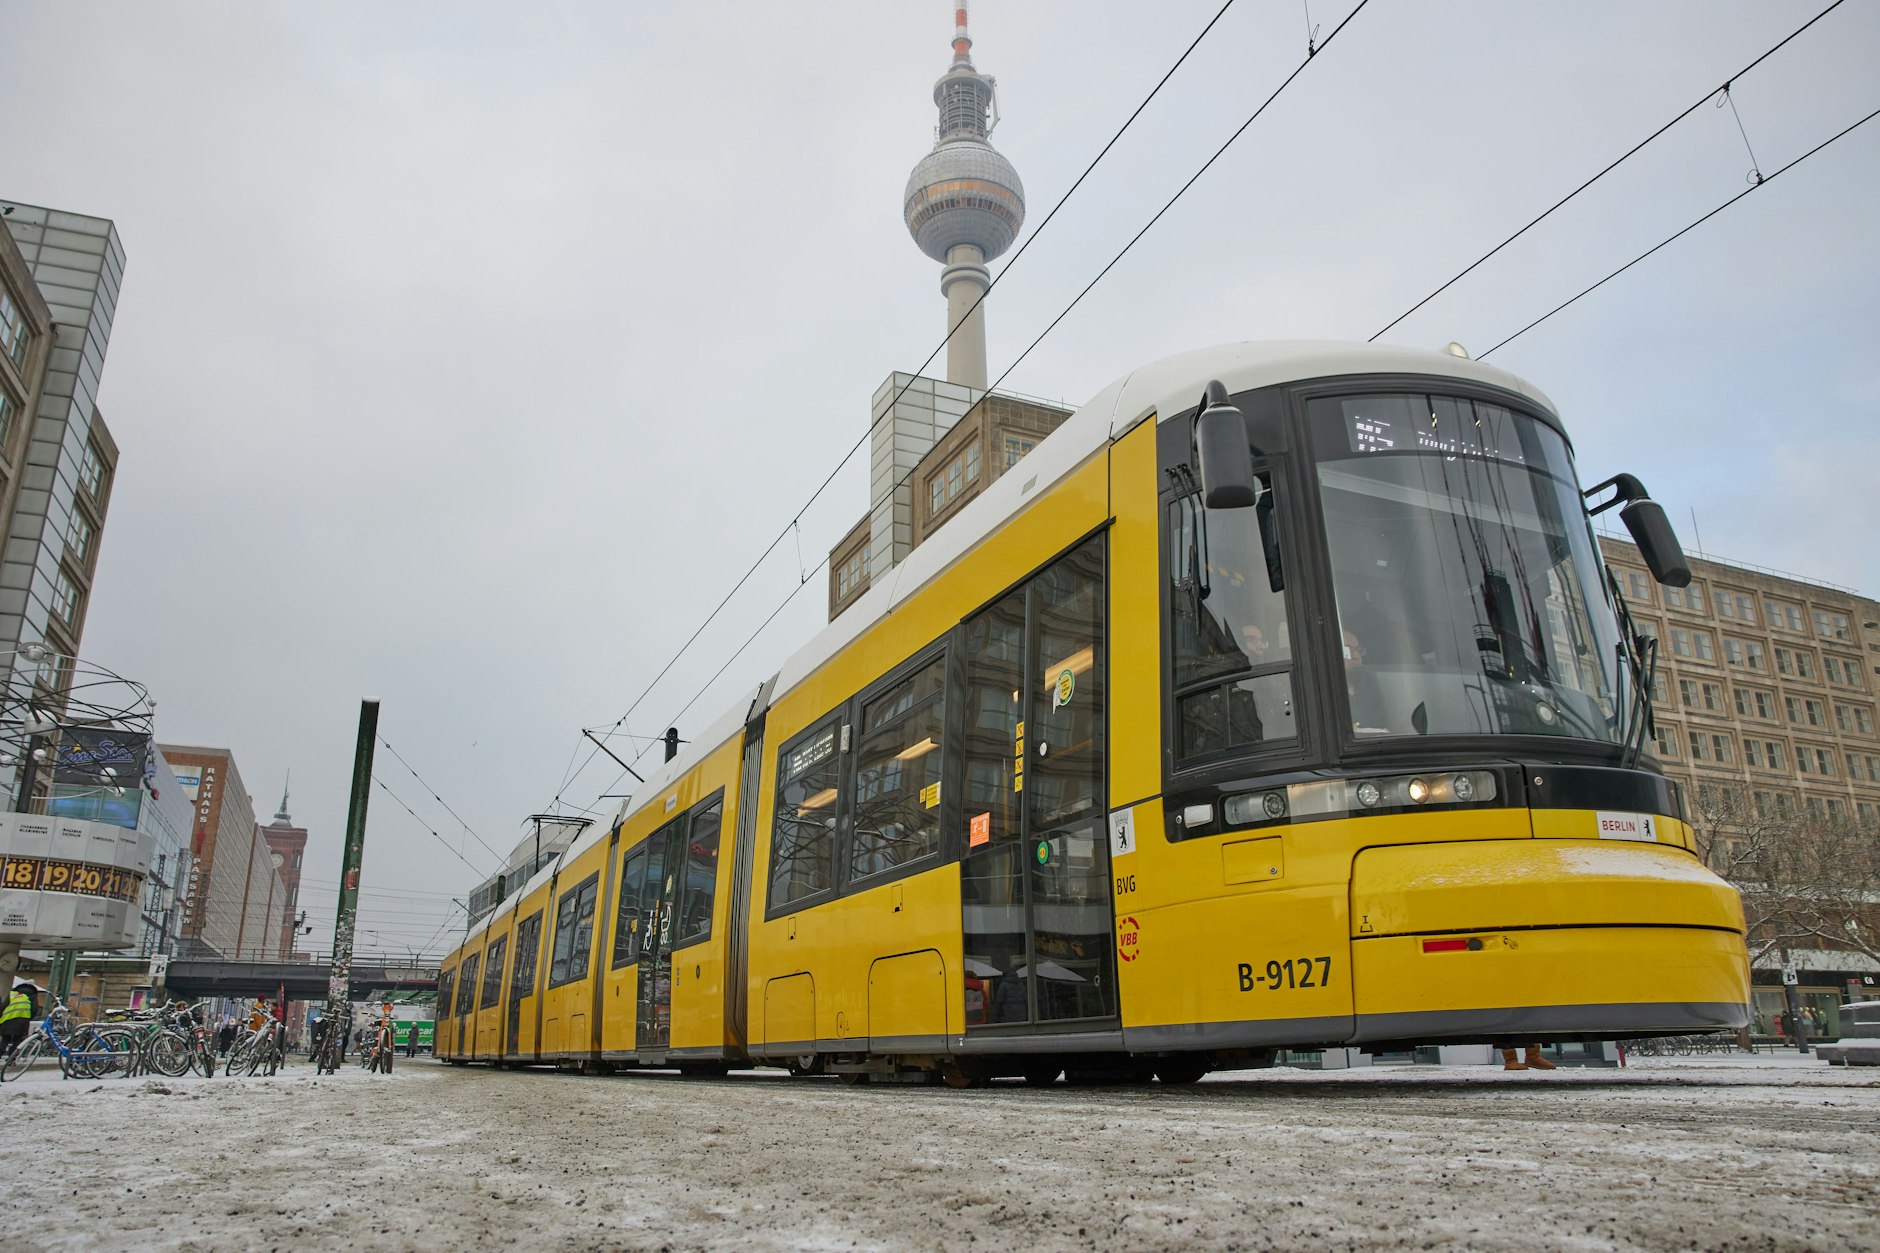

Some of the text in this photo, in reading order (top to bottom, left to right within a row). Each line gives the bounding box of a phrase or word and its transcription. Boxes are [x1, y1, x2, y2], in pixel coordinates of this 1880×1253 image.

[200, 767, 215, 823] RATHAUS
[1602, 820, 1636, 832] BERLIN
[6, 862, 33, 884] 18
[43, 866, 70, 885] 19
[72, 868, 101, 891] 20
[103, 872, 119, 893] 21
[1116, 875, 1136, 895] BVG
[183, 857, 201, 924] PASSAGEN
[1120, 932, 1138, 946] VBB
[1238, 956, 1332, 992] B-9127
[395, 1027, 434, 1036] Eurocar
